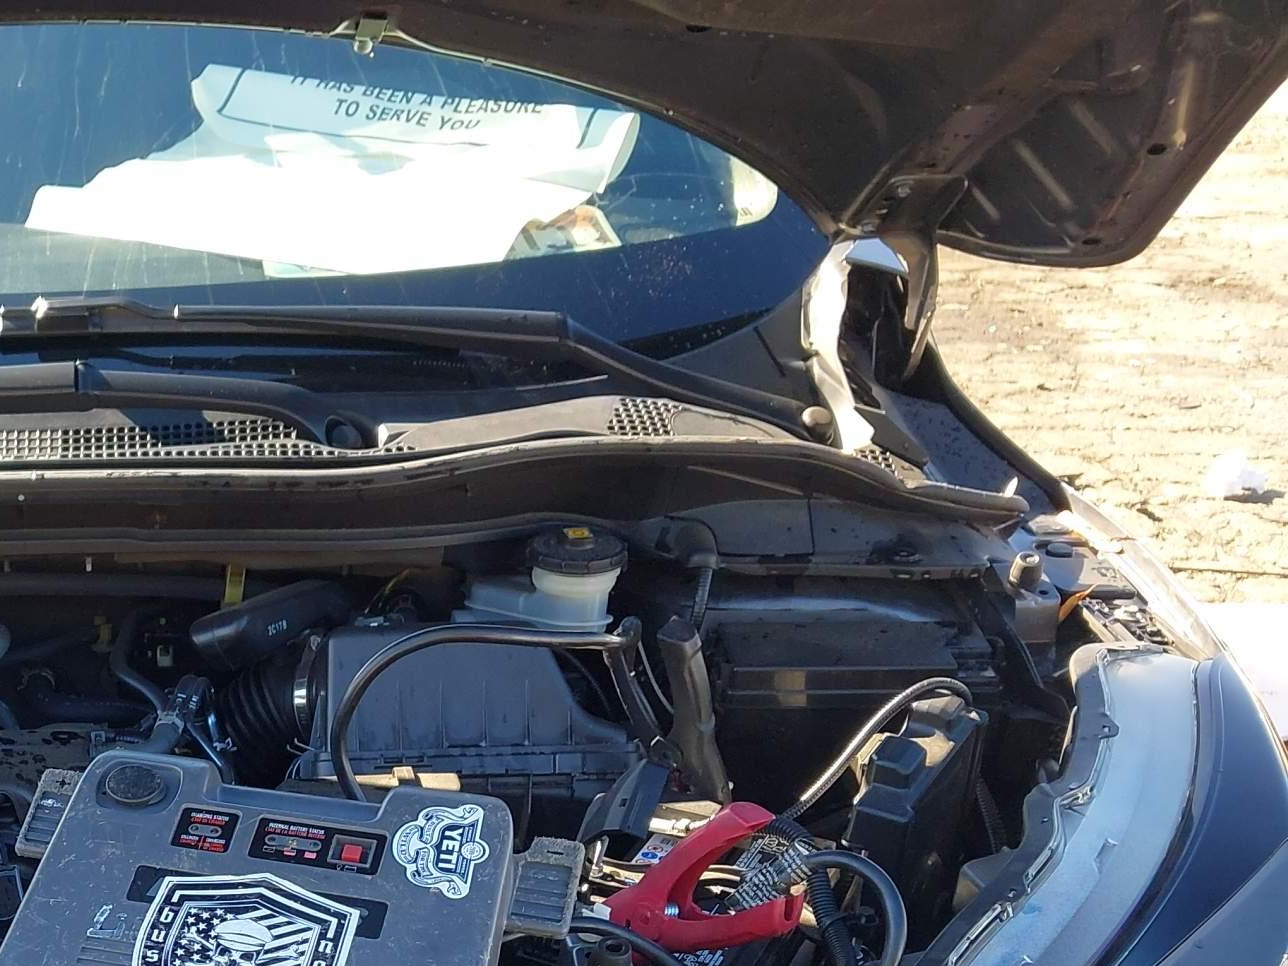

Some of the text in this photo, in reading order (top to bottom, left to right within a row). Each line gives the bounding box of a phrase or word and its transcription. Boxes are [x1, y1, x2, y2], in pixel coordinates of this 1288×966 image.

[334, 98, 481, 131] TO SERVE YOU
[361, 85, 416, 105] BEEN
[420, 95, 435, 107] A
[440, 95, 544, 114] PLEASURE
[437, 827, 464, 872] YETI
